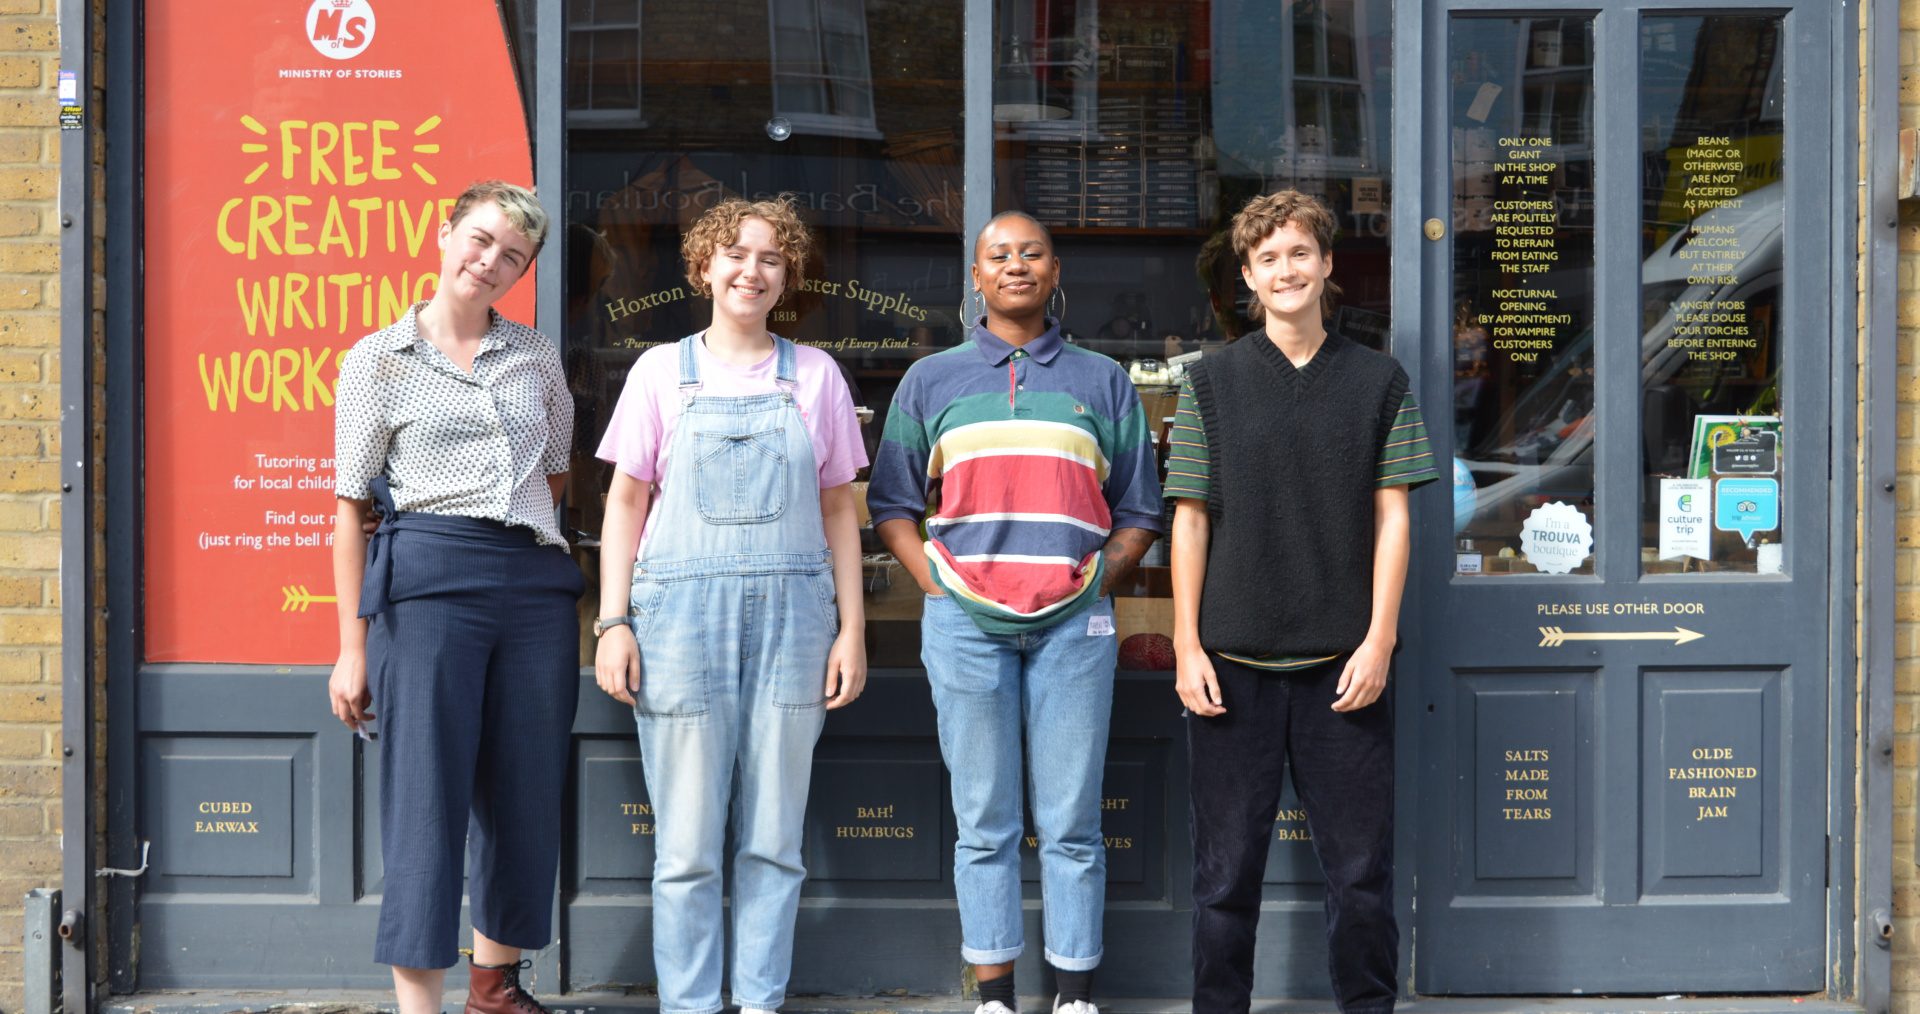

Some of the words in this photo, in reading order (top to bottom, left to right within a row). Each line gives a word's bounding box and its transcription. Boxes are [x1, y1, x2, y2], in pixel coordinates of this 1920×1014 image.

[336, 70, 351, 78] OF
[355, 70, 401, 78] STORIES
[1498, 138, 1527, 147] ONLY
[1528, 138, 1552, 147] ONE
[1698, 137, 1730, 146] BEANS
[280, 120, 401, 186] FREE
[1508, 151, 1541, 160] GIANT
[1686, 150, 1723, 159] (MAGIC
[1725, 150, 1741, 159] OR
[1494, 164, 1506, 172] IN
[1506, 163, 1527, 172] THE
[1529, 163, 1557, 172] SHOP
[1683, 162, 1744, 171] OTHERWISE)
[1502, 176, 1515, 185] AT
[1516, 176, 1524, 184] A
[1525, 176, 1548, 185] TIME
[1690, 175, 1711, 184] ARE
[1712, 175, 1735, 184] NOT
[1685, 187, 1738, 196] ACCEPTED
[1493, 201, 1553, 210] CUSTOMERS
[1683, 200, 1696, 209] AS
[1697, 200, 1743, 209] PAYMENT
[1490, 214, 1510, 223] ARE
[1511, 214, 1557, 223] POLITELY
[1496, 227, 1554, 236] REQUESTED
[1691, 226, 1735, 234] HUMANS
[1495, 239, 1511, 248] TO
[1512, 239, 1554, 248] REFRAIN
[1686, 238, 1741, 248] WELCOME,
[1491, 252, 1520, 261] FROM
[1521, 252, 1559, 261] EATING
[1679, 251, 1699, 260] BUT
[1701, 251, 1746, 260] ENTIRELY
[1500, 264, 1520, 273] THE
[1522, 264, 1550, 273] STAFF
[1691, 264, 1704, 272] AT
[1706, 264, 1734, 272] THEIR
[1687, 276, 1715, 285] OWN
[1717, 276, 1737, 285] RISK
[1492, 290, 1557, 299] NOCTURNAL
[605, 287, 685, 322] Hoxton
[799, 279, 841, 296] ster
[844, 279, 929, 322] Supplies
[1499, 302, 1547, 311] OPENING
[1680, 302, 1714, 310] ANGRY
[1717, 302, 1745, 310] MOBS
[773, 311, 797, 322] 1818
[1478, 315, 1494, 324] (BY
[1495, 315, 1571, 324] APPOINTMENT)
[1675, 314, 1709, 323] PLEASE
[1711, 314, 1746, 323] DOUSE
[1493, 328, 1514, 336] FOR
[1514, 328, 1556, 337] VAMPIRE
[1673, 327, 1701, 336] YOUR
[1702, 327, 1749, 336] TORCHES
[835, 337, 849, 352] of
[848, 338, 879, 352] Every
[880, 338, 909, 349] Kind
[1493, 340, 1553, 349] CUSTOMERS
[1667, 339, 1704, 348] BEFORE
[1706, 339, 1757, 348] ENTERING
[1510, 353, 1538, 362] ONLY
[1687, 352, 1707, 361] THE
[1709, 352, 1737, 361] SHOP
[198, 347, 348, 412] WORK
[255, 454, 316, 472] Tutoring
[234, 475, 255, 489] for
[260, 475, 292, 489] local
[265, 511, 295, 525] Find
[300, 513, 325, 525] out
[1667, 515, 1703, 524] culture
[1676, 525, 1694, 536] trip
[199, 531, 231, 550] (just
[235, 532, 263, 550] ring
[266, 532, 291, 546] the
[295, 532, 320, 546] bell
[1532, 530, 1580, 545] TROUVA
[1533, 542, 1578, 557] boutique
[1537, 604, 1582, 614] PLEASE
[1585, 604, 1610, 614] USE
[1613, 603, 1659, 614] OTHER
[1663, 603, 1705, 614] DOOR
[1505, 750, 1549, 761] SALTS
[1692, 749, 1733, 759] OLDE
[1505, 770, 1550, 780] MADE
[1669, 768, 1757, 779] FASHIONED
[1506, 789, 1549, 800] FROM
[1689, 787, 1736, 798] BRAIN
[199, 802, 253, 813] CUBED
[620, 803, 654, 815] TIN
[857, 805, 893, 818] BAH!
[1503, 808, 1552, 819] TEARS
[1696, 806, 1728, 820] JAM
[195, 822, 258, 832] EARWAX
[836, 827, 914, 838] HUMBUGS
[1278, 828, 1312, 841] BAL
